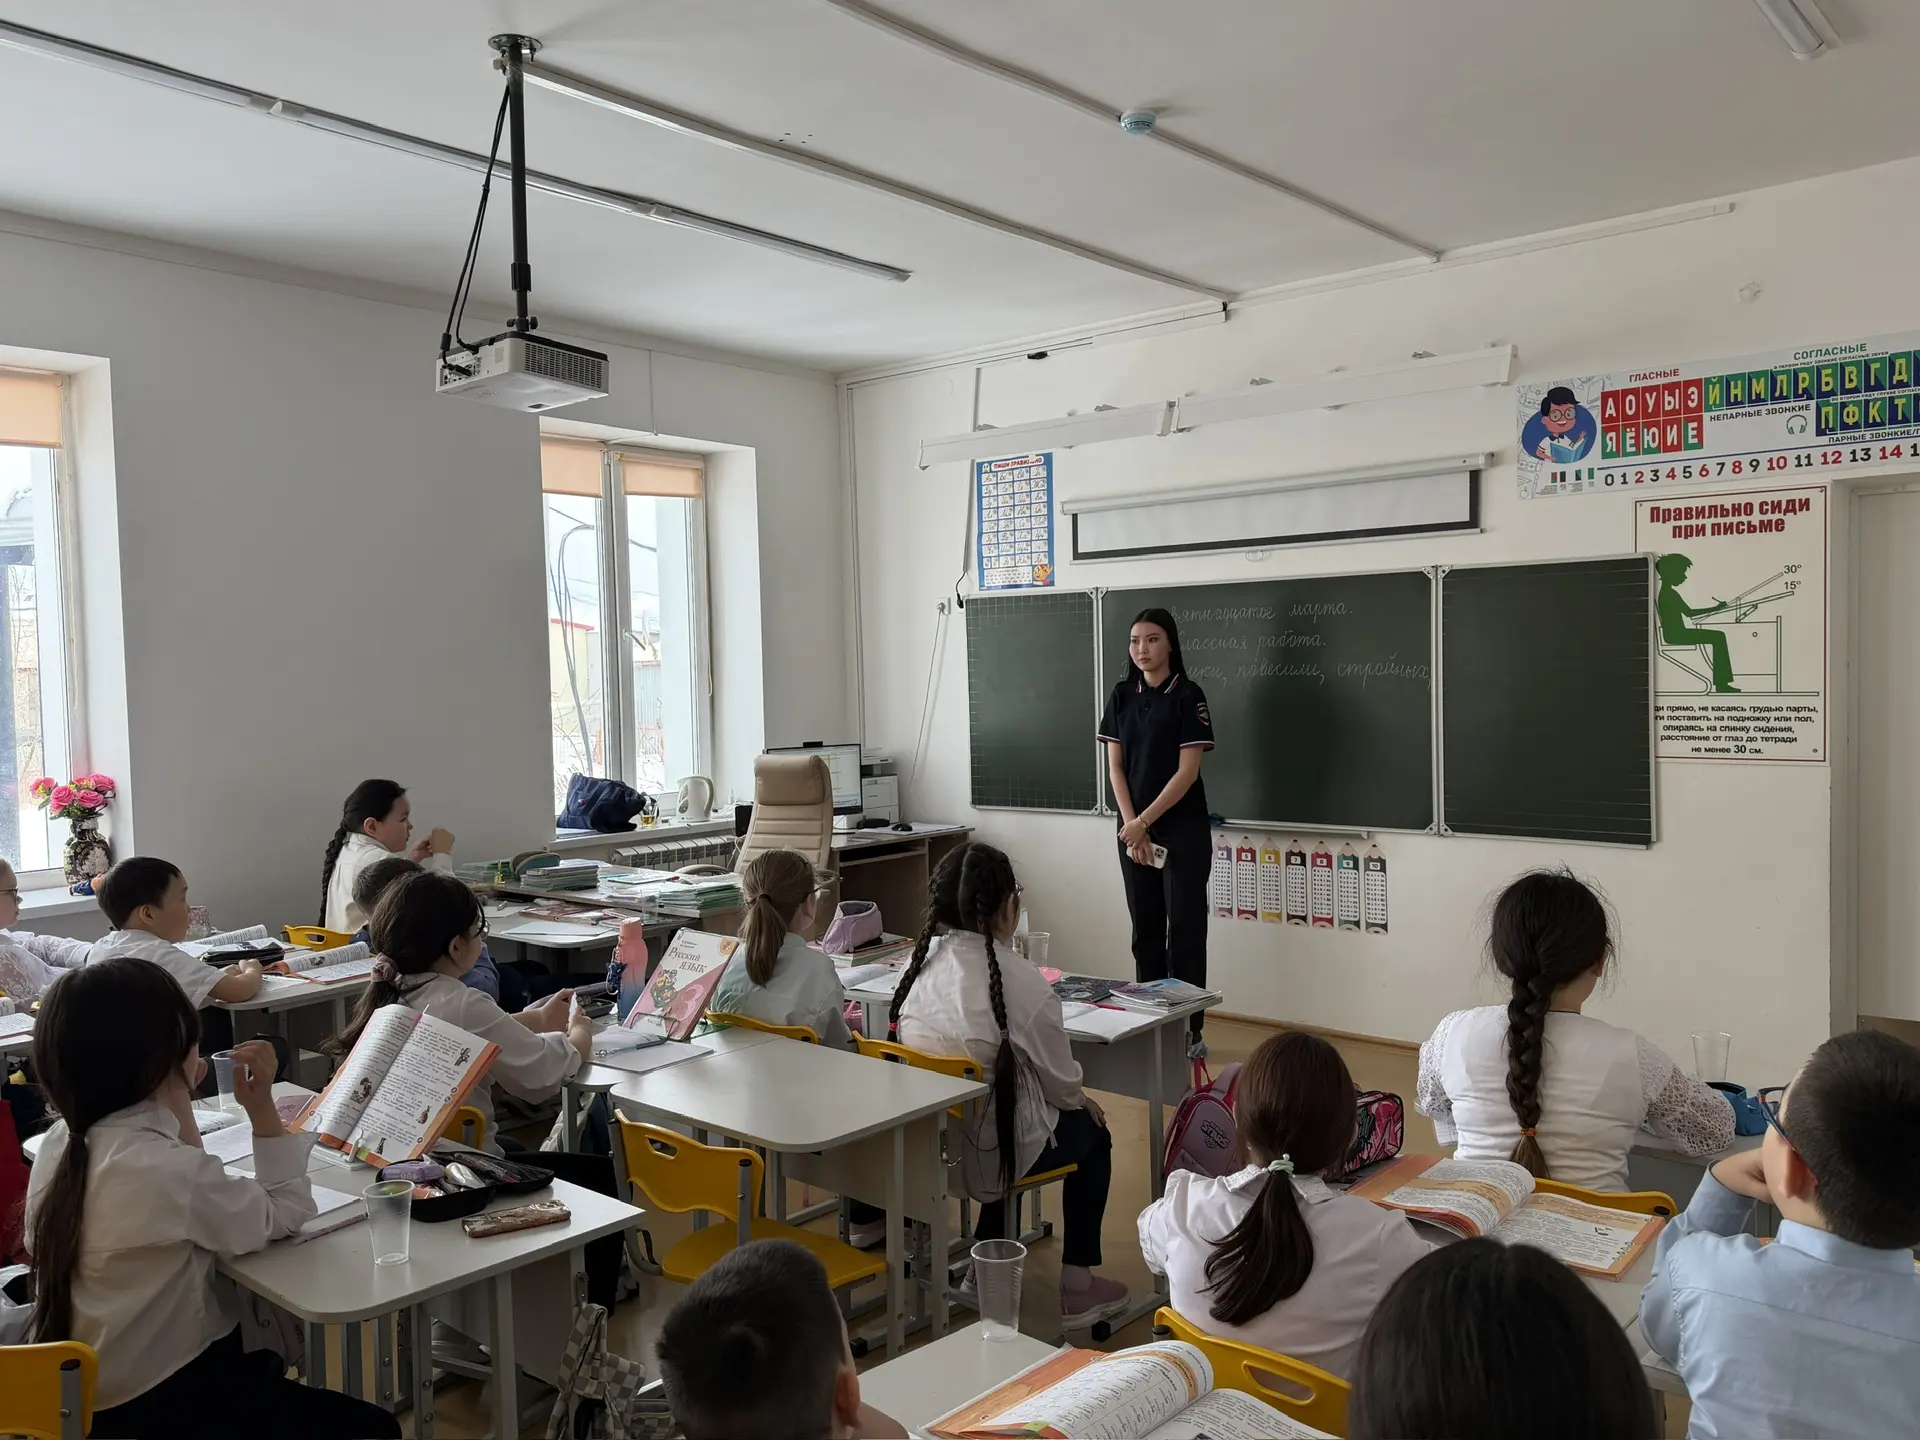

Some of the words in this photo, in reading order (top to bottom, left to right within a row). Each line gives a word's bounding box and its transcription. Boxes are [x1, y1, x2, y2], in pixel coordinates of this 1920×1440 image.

[1793, 343, 1867, 361] СОГЛАСНЫЕ
[1838, 353, 1870, 361] СОГЛАСНЫЕ
[1629, 368, 1680, 382] ГЛАСНЫЕ
[1709, 409, 1763, 422] НЕПАРНЫЕ
[1765, 403, 1811, 416] ЗВОНКИЕ
[1828, 433, 1867, 443] ПАРНЫЕ
[1604, 474, 1615, 487] 0
[1620, 473, 1628, 485] 1
[1634, 471, 1645, 484] 2
[1650, 469, 1660, 482] 3
[1665, 467, 1677, 480] 4
[1682, 465, 1693, 479] 5
[1698, 464, 1710, 478] 6
[1716, 462, 1726, 476] 7
[1731, 460, 1743, 474] 8
[1748, 458, 1761, 473] 9
[1766, 455, 1788, 472] 10
[1794, 453, 1813, 468] 11
[1820, 450, 1842, 466] 12
[1849, 447, 1871, 463] 13
[1879, 444, 1903, 460] 14
[1650, 501, 1754, 524] Правильно
[1759, 498, 1811, 516] сиди
[1672, 523, 1706, 539] при
[1711, 518, 1786, 537] письме
[1254, 629, 1328, 662] работа.
[1666, 705, 1696, 714] прямо,
[1749, 705, 1784, 714] грудью
[1786, 705, 1819, 714] парты,
[1727, 715, 1771, 724] подножку
[1794, 715, 1815, 724] пол,
[1662, 724, 1704, 733] опираясь
[1719, 725, 1751, 734] спинку
[1753, 725, 1795, 734] сидения,
[1660, 734, 1710, 742] расстояние
[1745, 735, 1758, 743] до
[1760, 735, 1798, 744] тетради
[1733, 744, 1747, 754] 30
[668, 946, 701, 962] Русский
